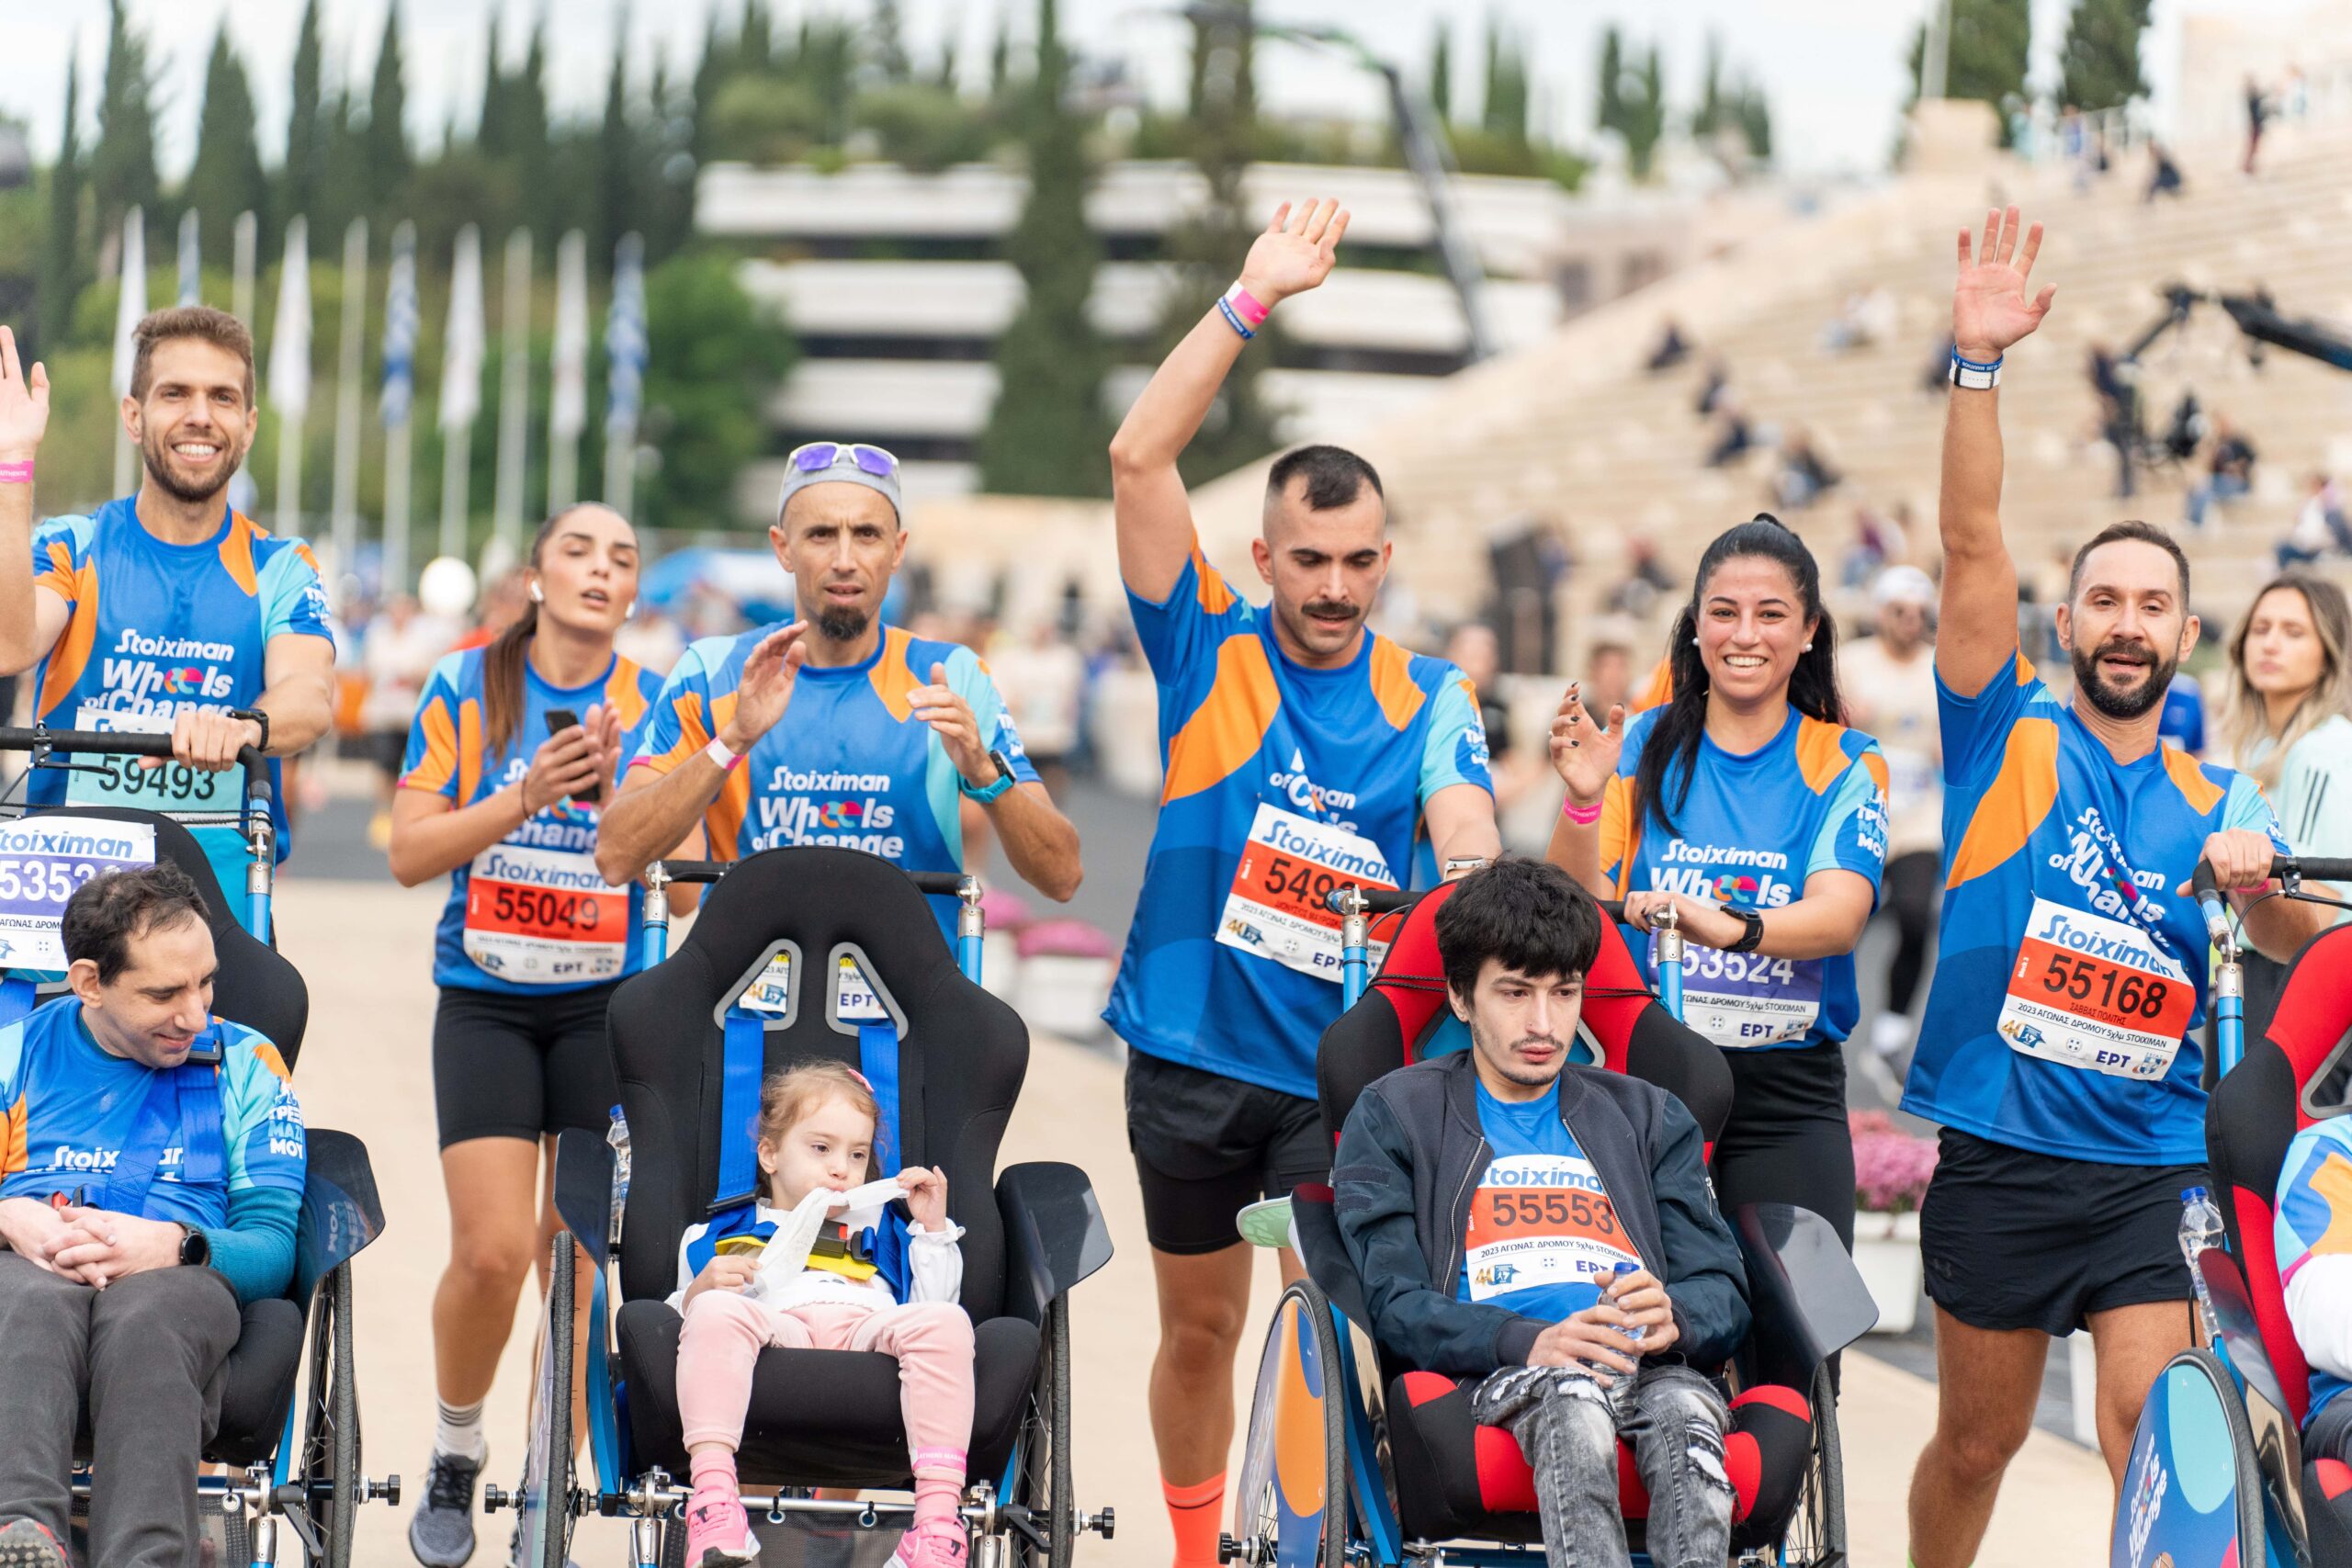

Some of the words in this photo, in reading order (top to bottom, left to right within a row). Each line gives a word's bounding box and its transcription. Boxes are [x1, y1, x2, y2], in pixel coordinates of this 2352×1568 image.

[114, 628, 235, 661] Stoiximan
[103, 658, 234, 698] Wheels
[85, 692, 108, 709] of
[98, 755, 215, 800] 59493
[768, 765, 891, 792] Stoiximan
[1269, 772, 1293, 793] of
[759, 796, 895, 829] Wheels
[752, 832, 769, 852] of
[1661, 839, 1787, 870] Stoiximan
[2048, 853, 2075, 871] of
[1650, 867, 1791, 908] Wheels
[493, 886, 601, 931] 55049
[35, 920, 62, 930] ΔΡΟΜ
[1682, 943, 1794, 986] 53524
[840, 993, 873, 1007] ΕΡΤ
[2043, 953, 2167, 1019] 55168
[1740, 1023, 1774, 1038] ΕΡΤ
[2018, 1002, 2038, 1016] 2023
[2037, 1009, 2069, 1025] ΑΓΩΝΑΣ
[2071, 1019, 2107, 1036] ΔΡΟΜΟΥ
[2096, 1049, 2132, 1068] ΕΡΤ
[1477, 1167, 1605, 1193] toixima
[1493, 1193, 1614, 1235] 55553
[1481, 1247, 1499, 1258] 2023
[1500, 1241, 1536, 1253] ΑΓΩΝΑΣ
[1537, 1240, 1575, 1248] ΔΡΟΜΟΥ
